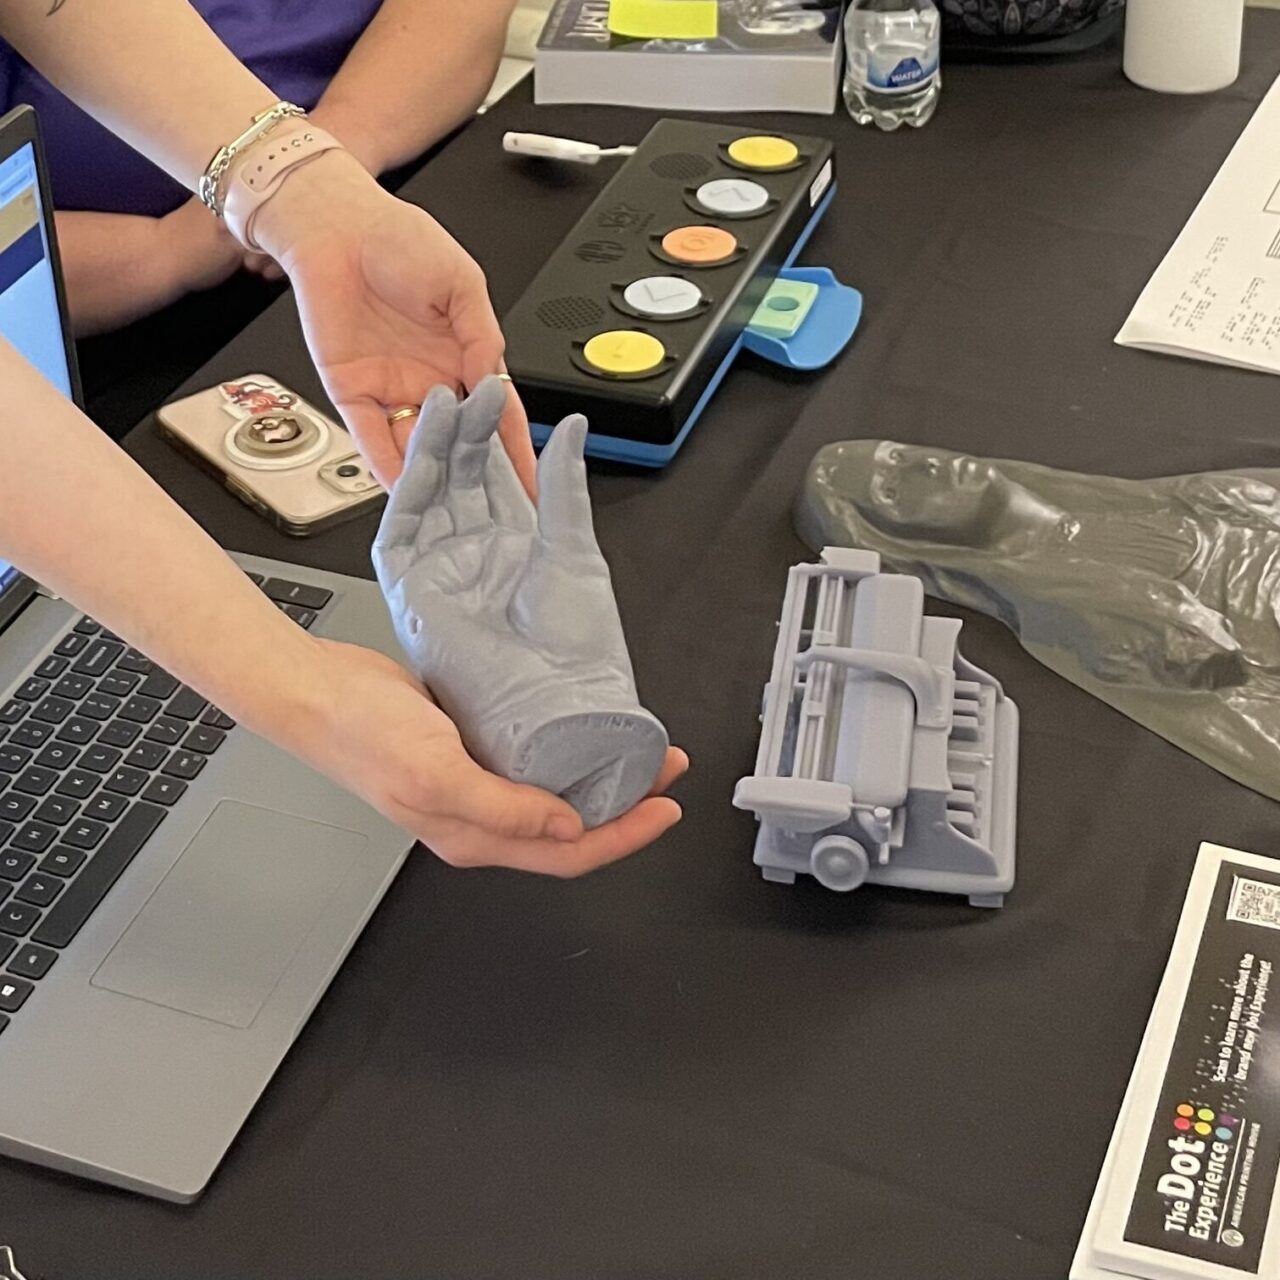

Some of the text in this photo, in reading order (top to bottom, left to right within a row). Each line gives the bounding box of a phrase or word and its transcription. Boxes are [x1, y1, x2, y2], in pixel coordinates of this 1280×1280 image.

[1211, 953, 1255, 1082] Scan to learn more about the
[1234, 1049, 1252, 1080] brand
[1243, 1029, 1256, 1051] new
[1157, 1136, 1205, 1232] The Dot
[1189, 1141, 1229, 1240] Experience
[1231, 1186, 1248, 1228] AMERICAN
[1240, 1148, 1255, 1185] PRINTING
